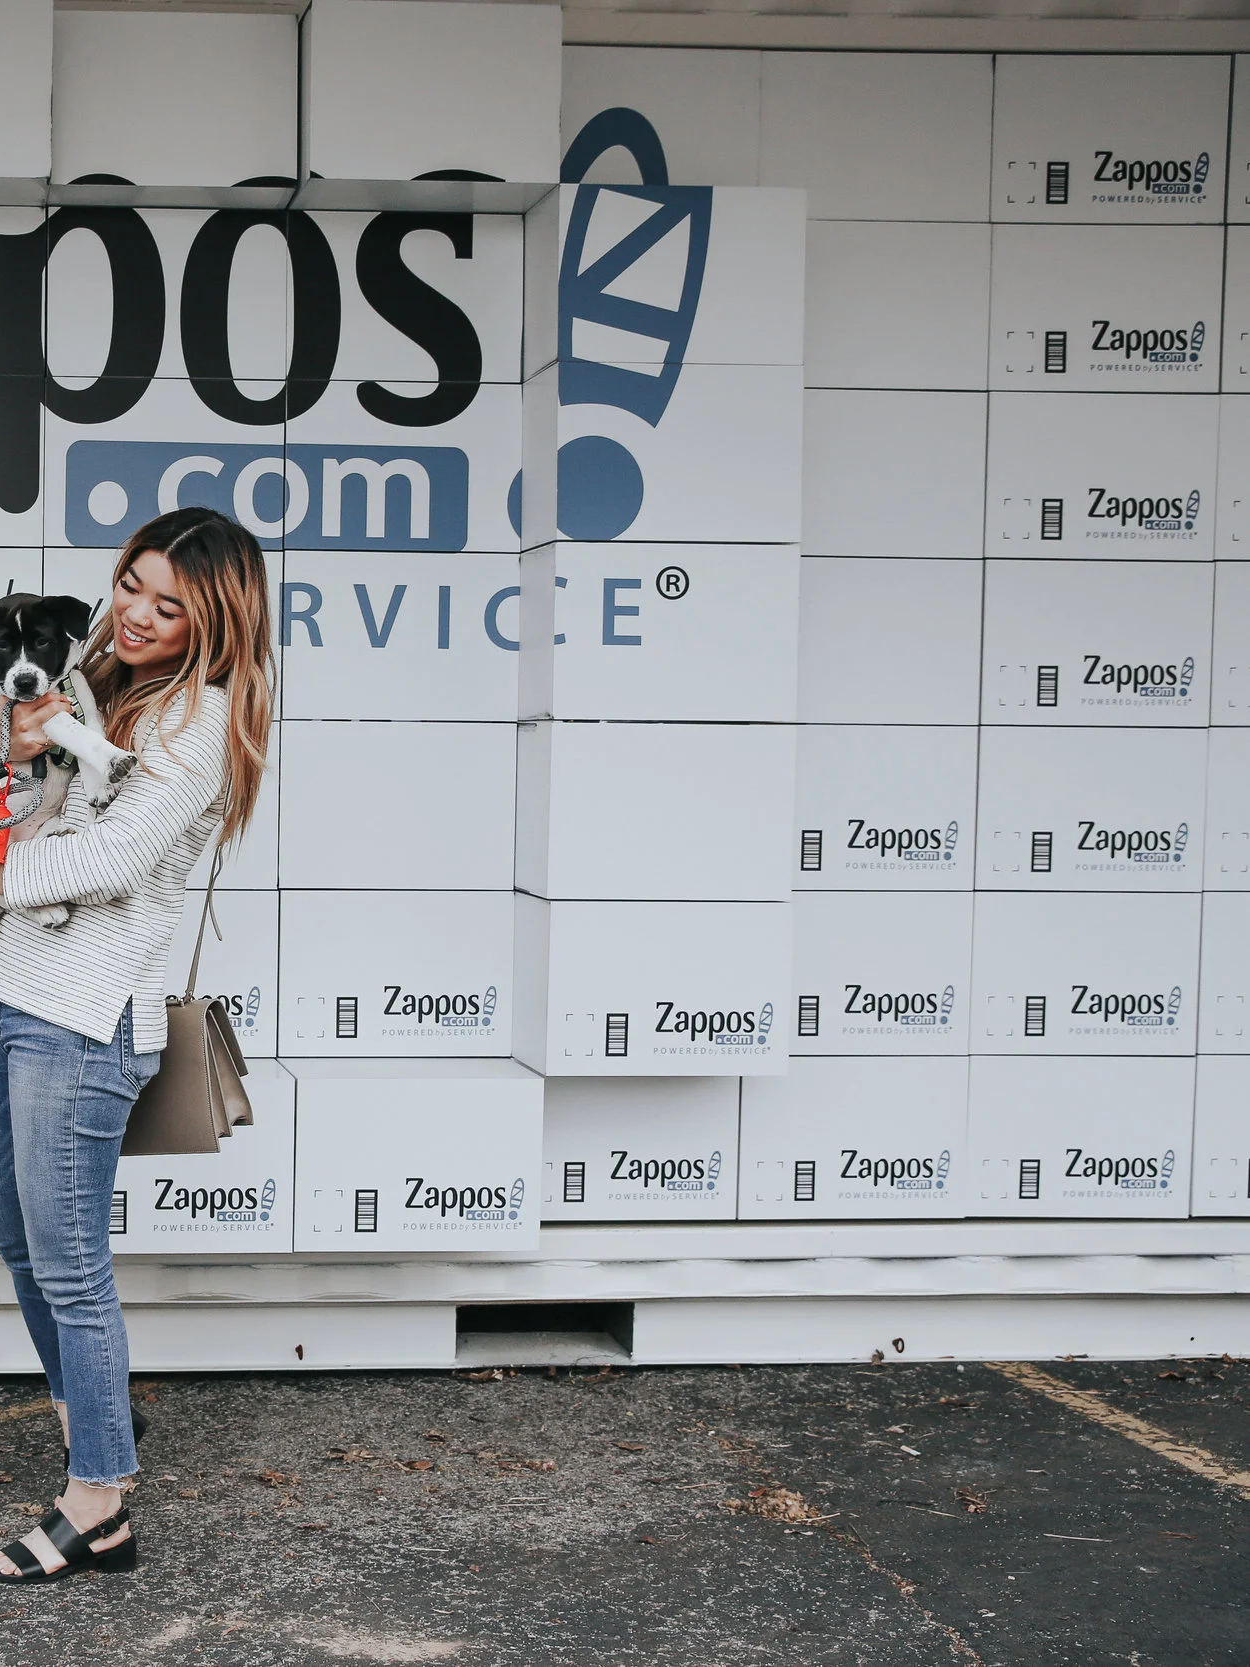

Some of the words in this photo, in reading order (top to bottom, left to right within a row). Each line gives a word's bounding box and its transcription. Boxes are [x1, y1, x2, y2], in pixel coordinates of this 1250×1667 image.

[1094, 150, 1192, 190] Zappos
[1092, 320, 1188, 360] Zappos
[87, 456, 430, 540] .com
[1088, 488, 1182, 527] Zappos
[1084, 656, 1178, 694] Zappos
[848, 820, 942, 858] Zappos
[1078, 822, 1170, 859] Zappos
[384, 986, 480, 1025] Zappos
[656, 1002, 756, 1042] Zappos
[844, 984, 938, 1022] Zappos
[1072, 986, 1164, 1023] Zappos
[610, 1150, 704, 1189] Zappos
[840, 1150, 934, 1187] Zappos
[1066, 1148, 1158, 1186] Zappos
[154, 1180, 258, 1221] Zappos
[404, 1178, 506, 1219] Zappos
[153, 1224, 208, 1232] POWERED
